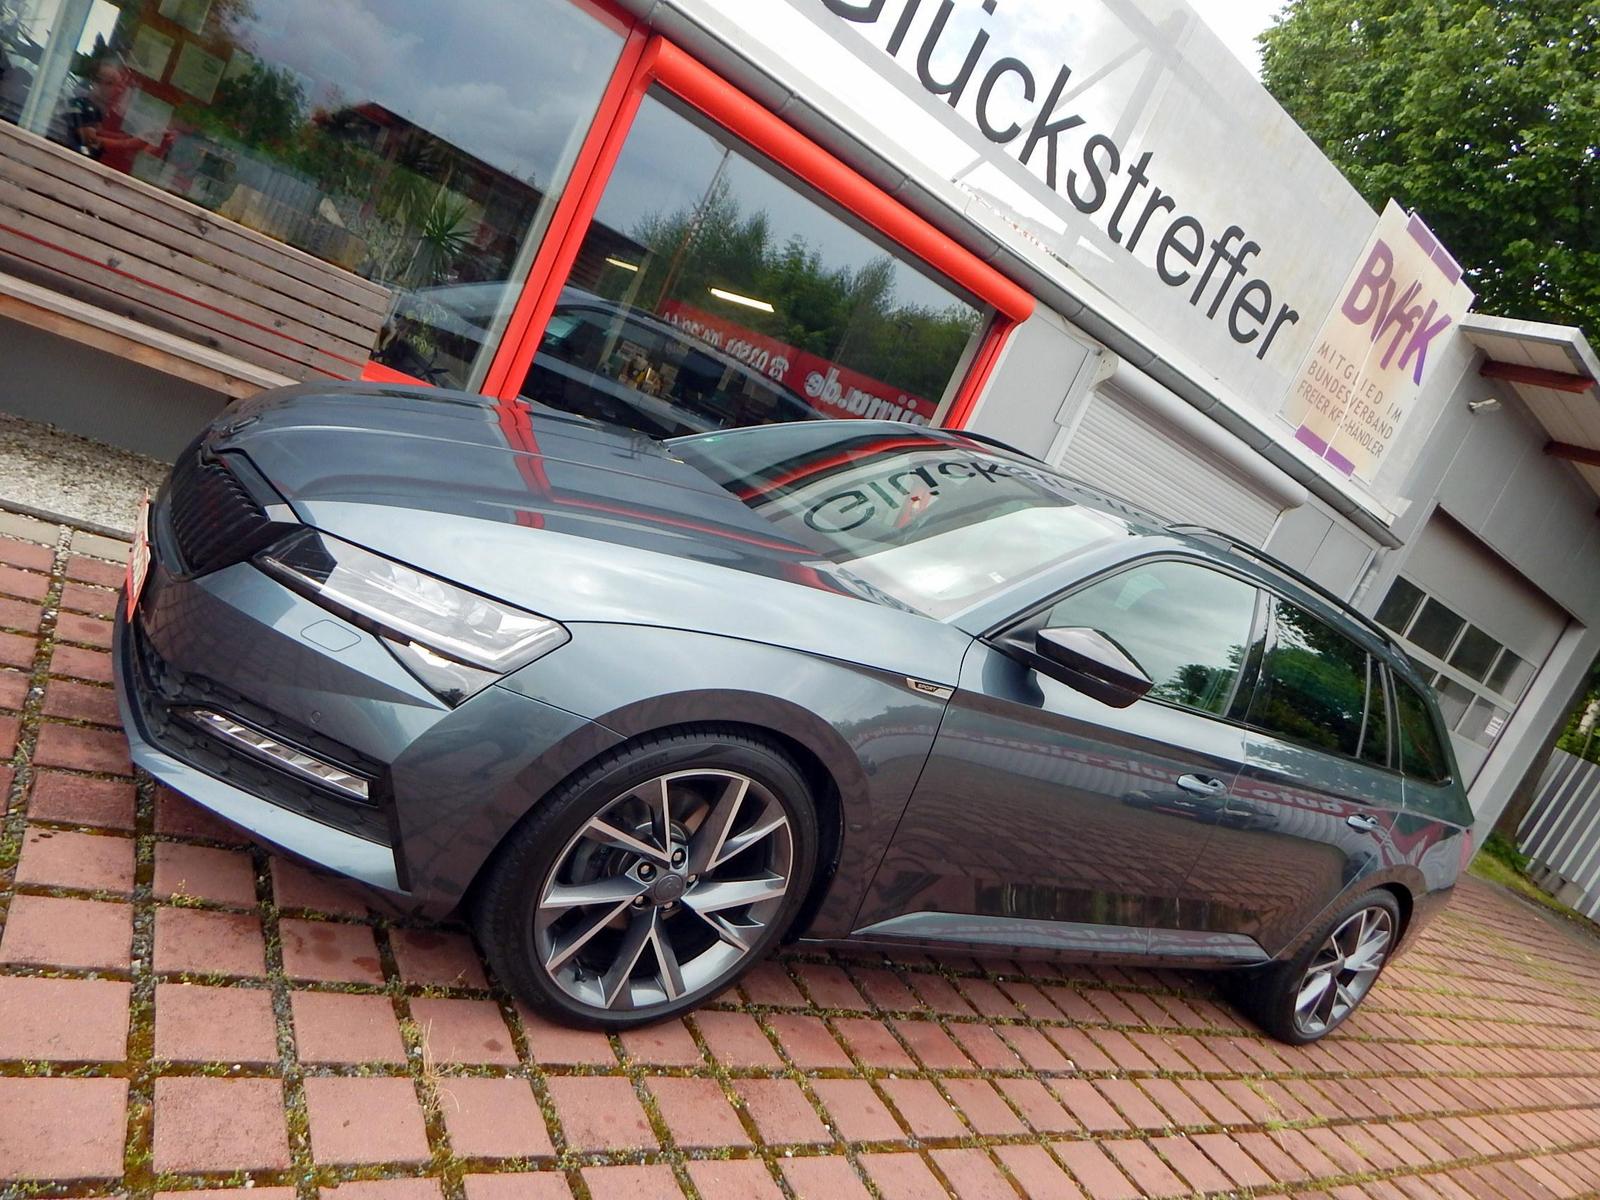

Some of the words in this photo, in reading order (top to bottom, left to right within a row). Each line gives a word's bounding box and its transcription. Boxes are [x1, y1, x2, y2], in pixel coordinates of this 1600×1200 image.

[822, 0, 1299, 360] lückstreffer
[1297, 380, 1330, 416] FREIER
[1308, 360, 1393, 440] BUNDESVERBAND
[1317, 341, 1383, 405] MITGLIED
[1387, 402, 1402, 423] IM
